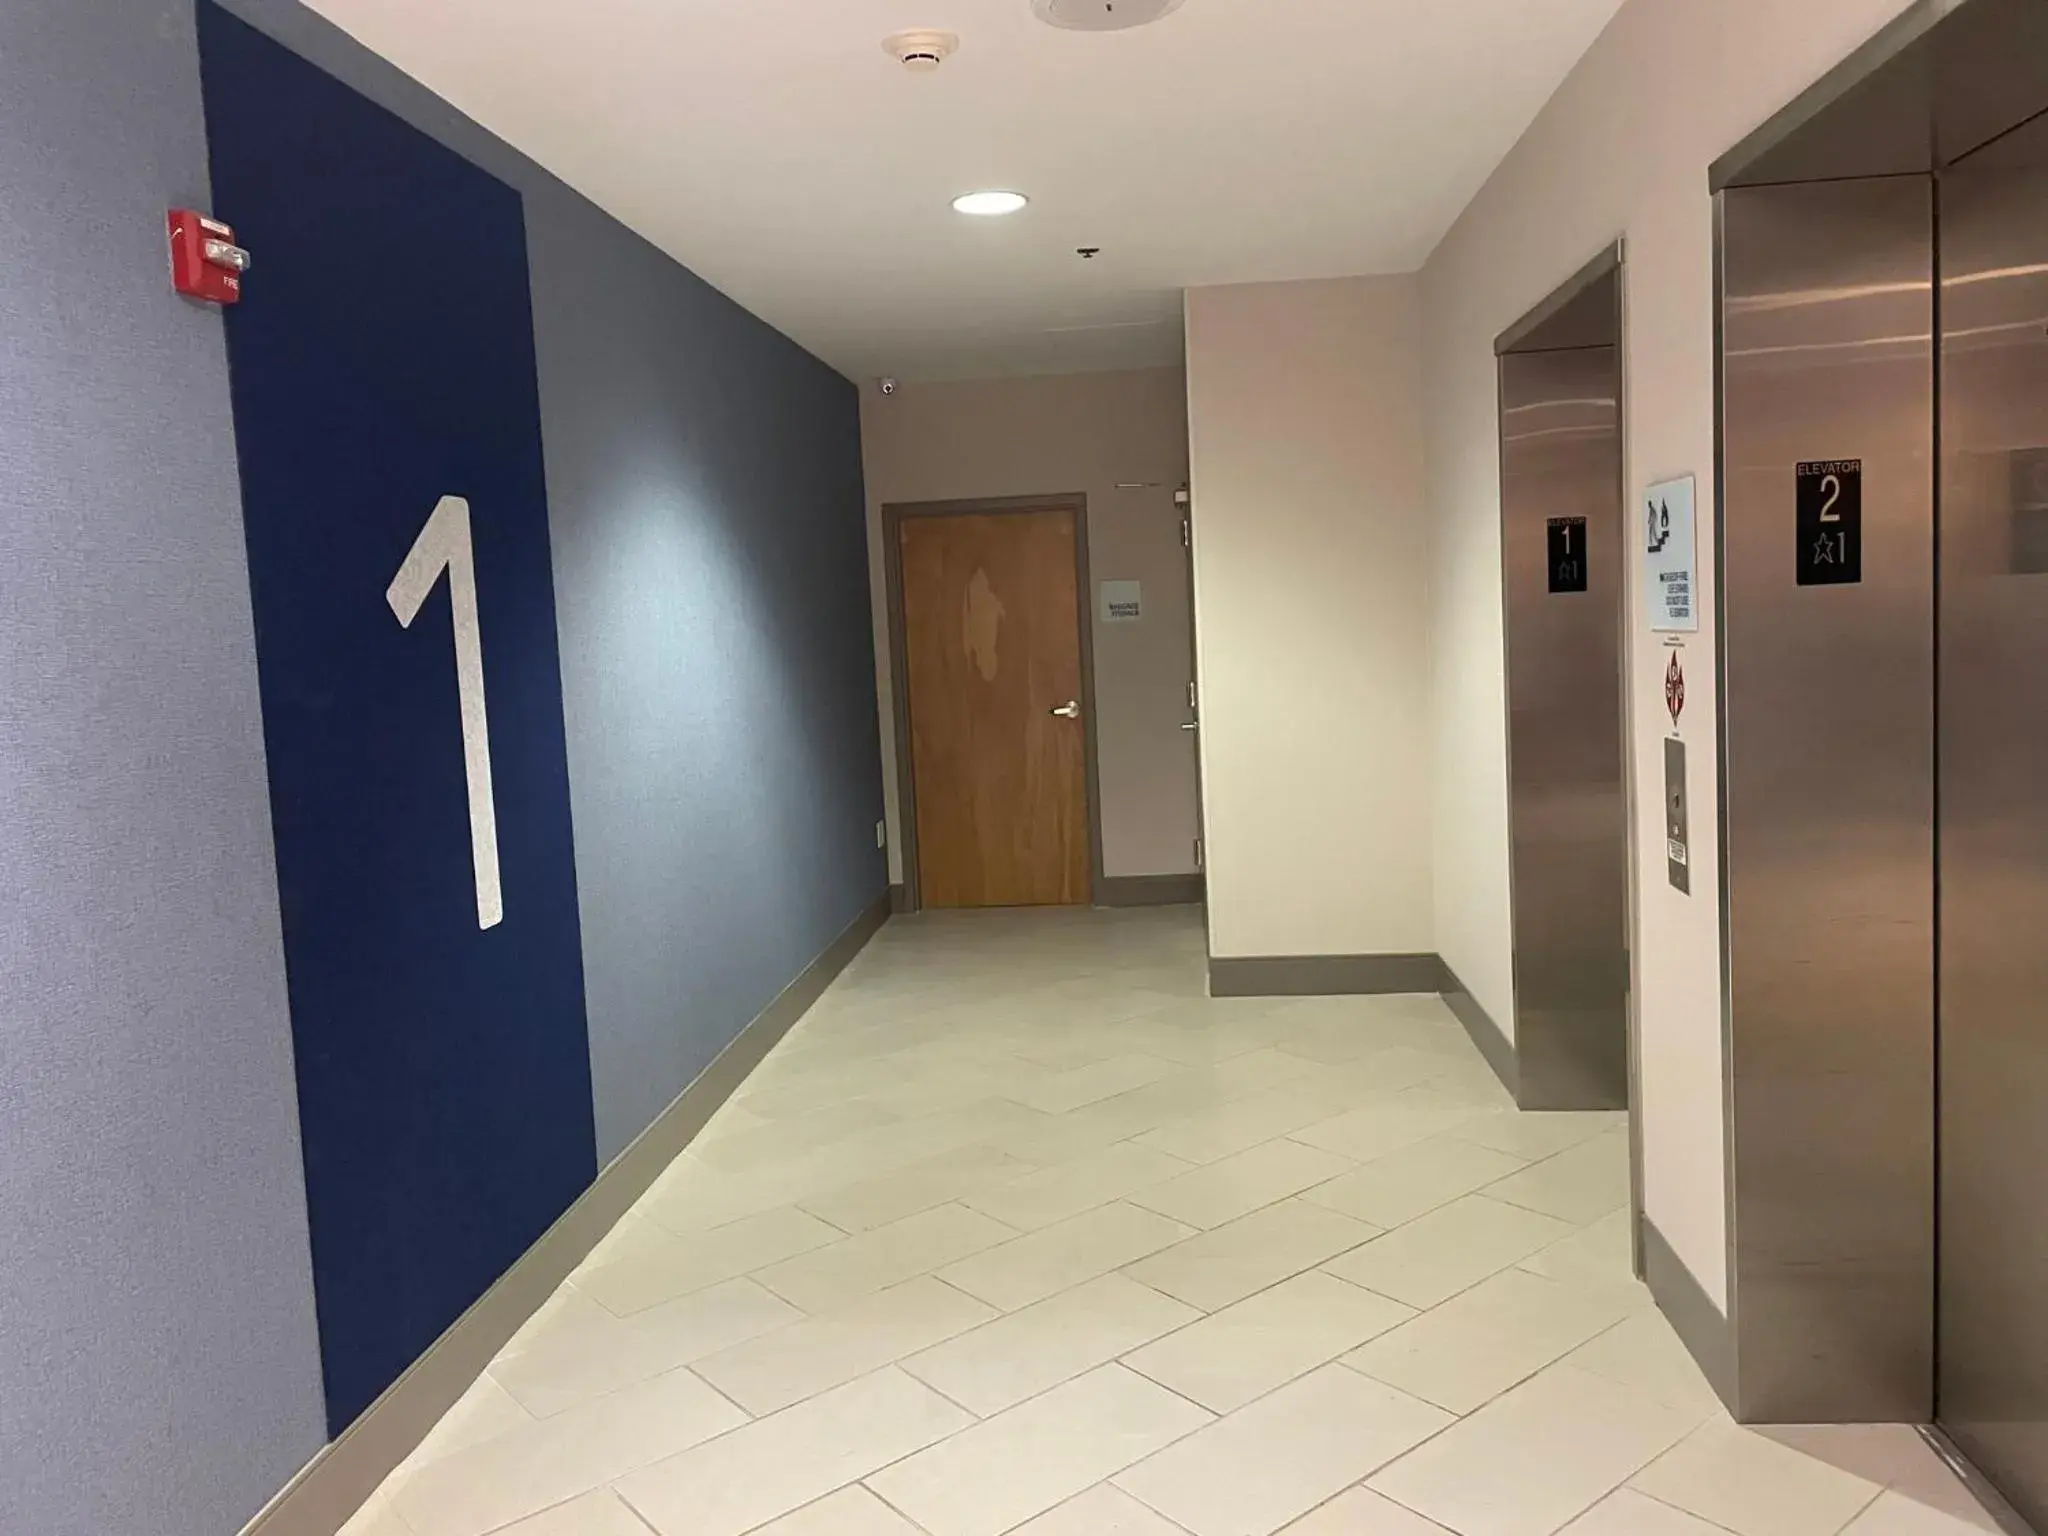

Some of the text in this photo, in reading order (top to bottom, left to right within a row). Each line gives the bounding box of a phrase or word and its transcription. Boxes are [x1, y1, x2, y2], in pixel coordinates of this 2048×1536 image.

[1797, 461, 1860, 476] ELEVATOR
[1820, 474, 1841, 522] 2
[1562, 525, 1570, 554] 1
[386, 494, 503, 930] 1
